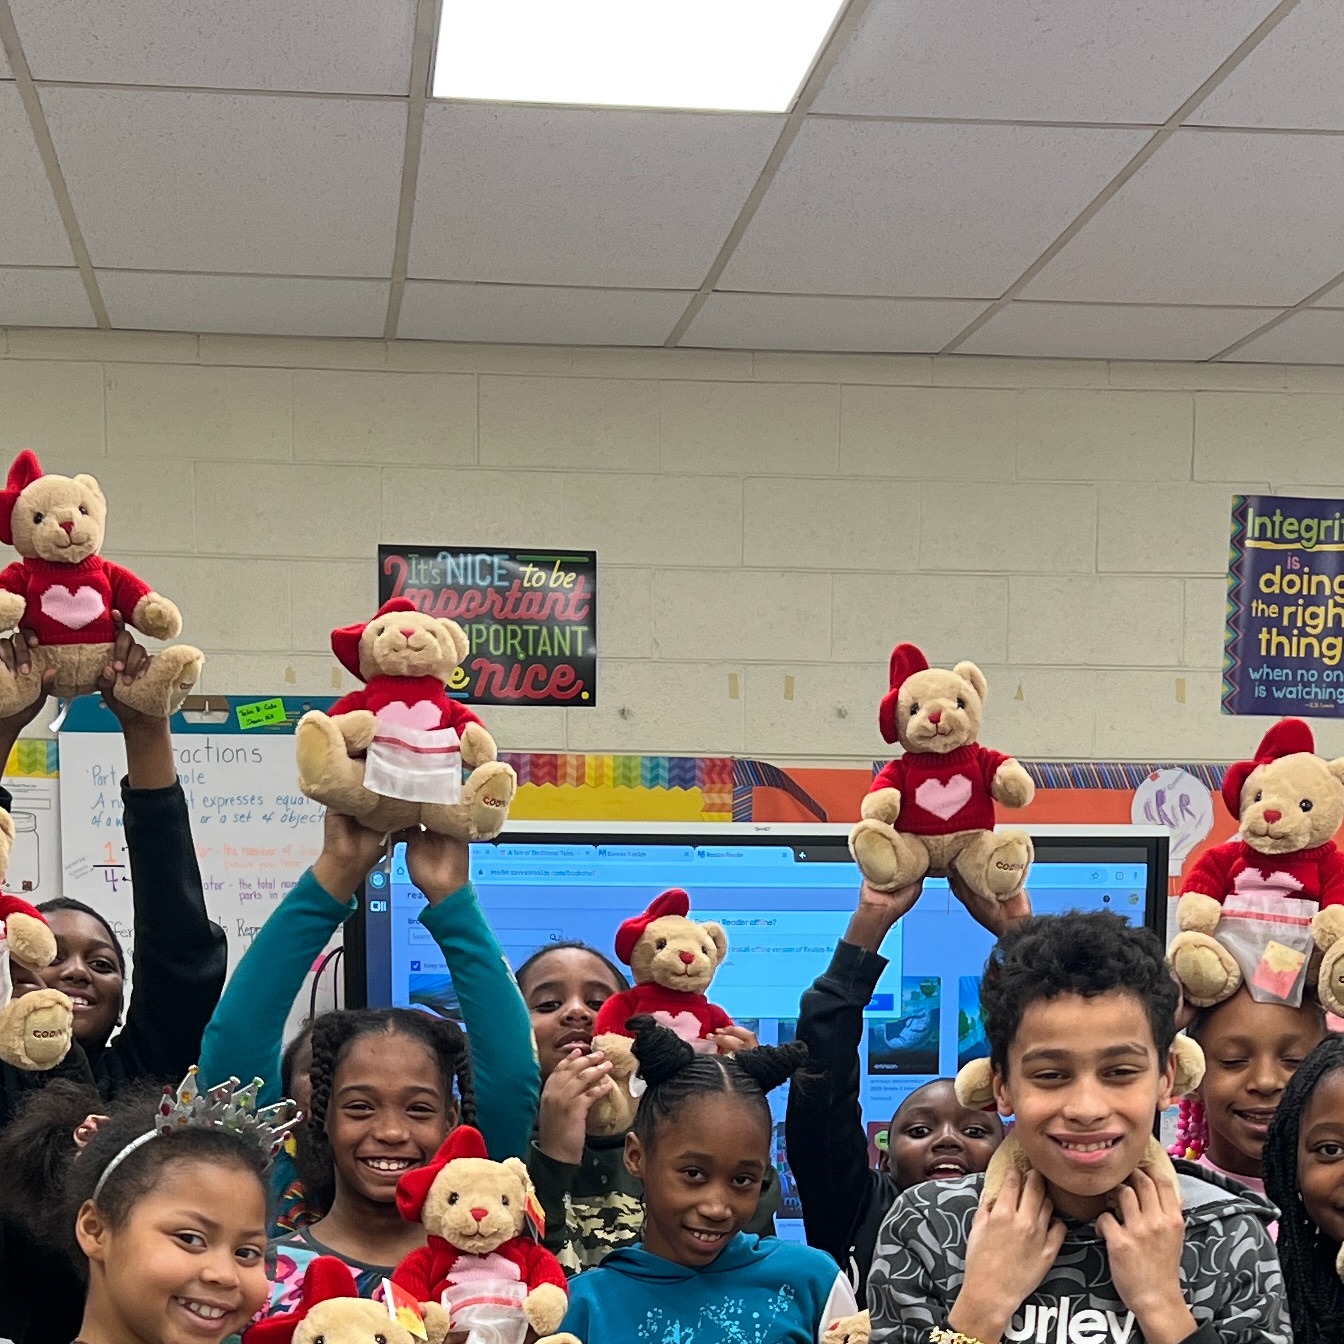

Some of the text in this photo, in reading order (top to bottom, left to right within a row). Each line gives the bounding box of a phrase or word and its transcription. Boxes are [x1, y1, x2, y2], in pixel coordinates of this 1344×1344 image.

[408, 551, 577, 588] It's NICE to be
[1287, 552, 1301, 570] is
[1251, 599, 1279, 617] the
[464, 624, 589, 657] PORTANT
[1258, 627, 1343, 666] thing
[1248, 664, 1293, 683] when
[1297, 668, 1318, 682] no
[1254, 682, 1267, 698] is
[92, 764, 117, 786] Part
[203, 794, 264, 814] expresses
[234, 813, 252, 823] set
[105, 869, 118, 892] 4
[239, 878, 252, 890] the
[258, 877, 275, 890] total
[239, 891, 262, 905] parts
